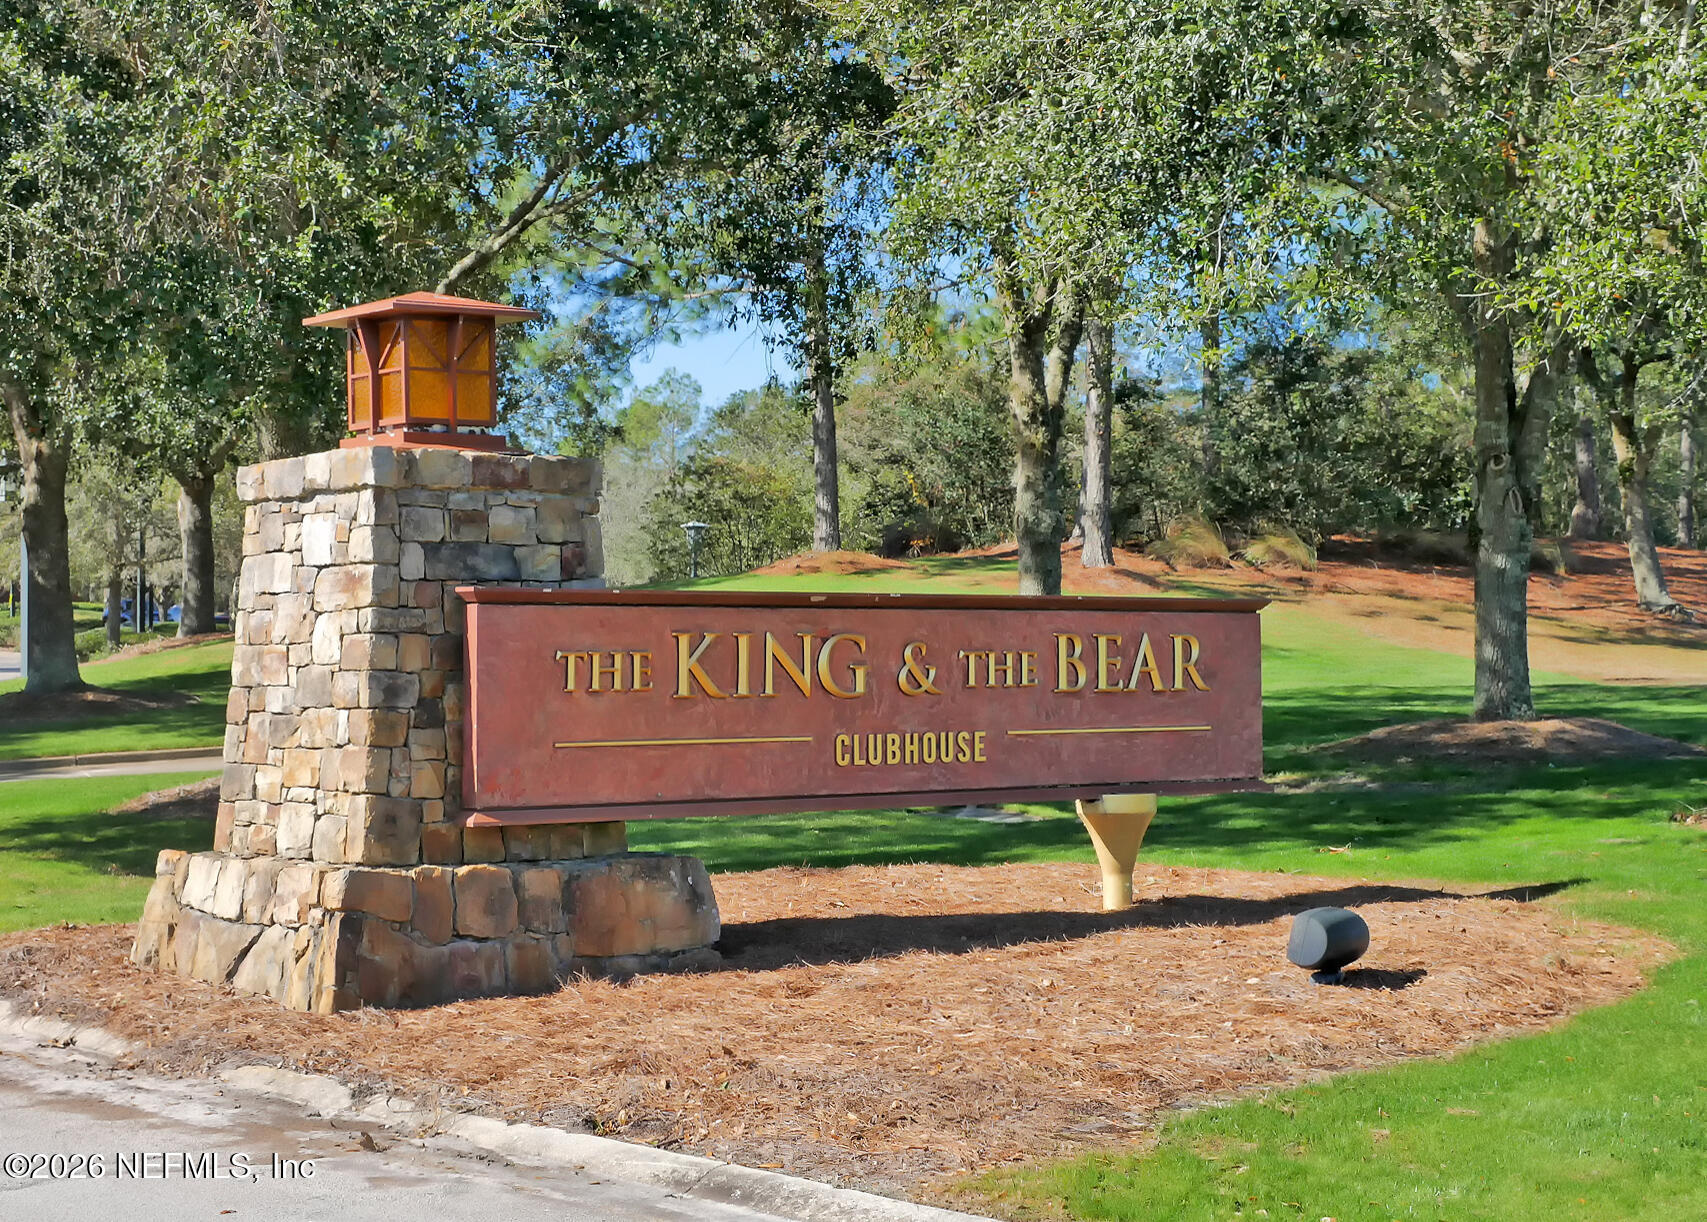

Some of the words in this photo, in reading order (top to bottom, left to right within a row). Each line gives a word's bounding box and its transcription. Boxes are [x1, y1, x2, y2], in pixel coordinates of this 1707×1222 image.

[555, 650, 653, 693] THE
[671, 631, 868, 698] KING
[898, 642, 943, 696] &
[958, 650, 1038, 688] THE
[1053, 632, 1211, 693] BEAR
[835, 731, 986, 766] CLUBHOUSE
